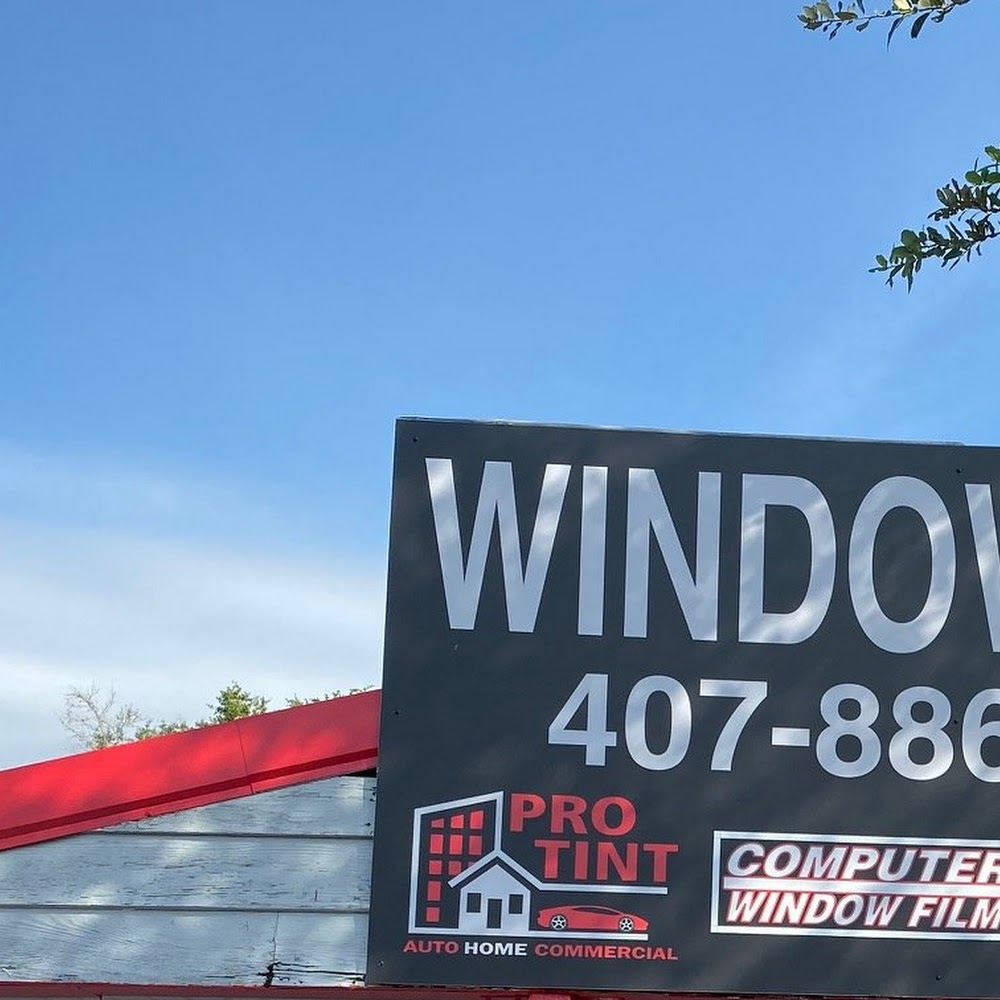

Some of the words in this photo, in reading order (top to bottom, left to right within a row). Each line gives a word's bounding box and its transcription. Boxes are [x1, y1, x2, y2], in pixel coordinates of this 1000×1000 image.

[509, 793, 637, 836] PRO
[534, 839, 679, 883] TINT
[726, 890, 903, 927] WINDOW
[403, 939, 460, 955] AUTO
[463, 941, 528, 957] HOME
[534, 943, 679, 961] COMMERCIAL
